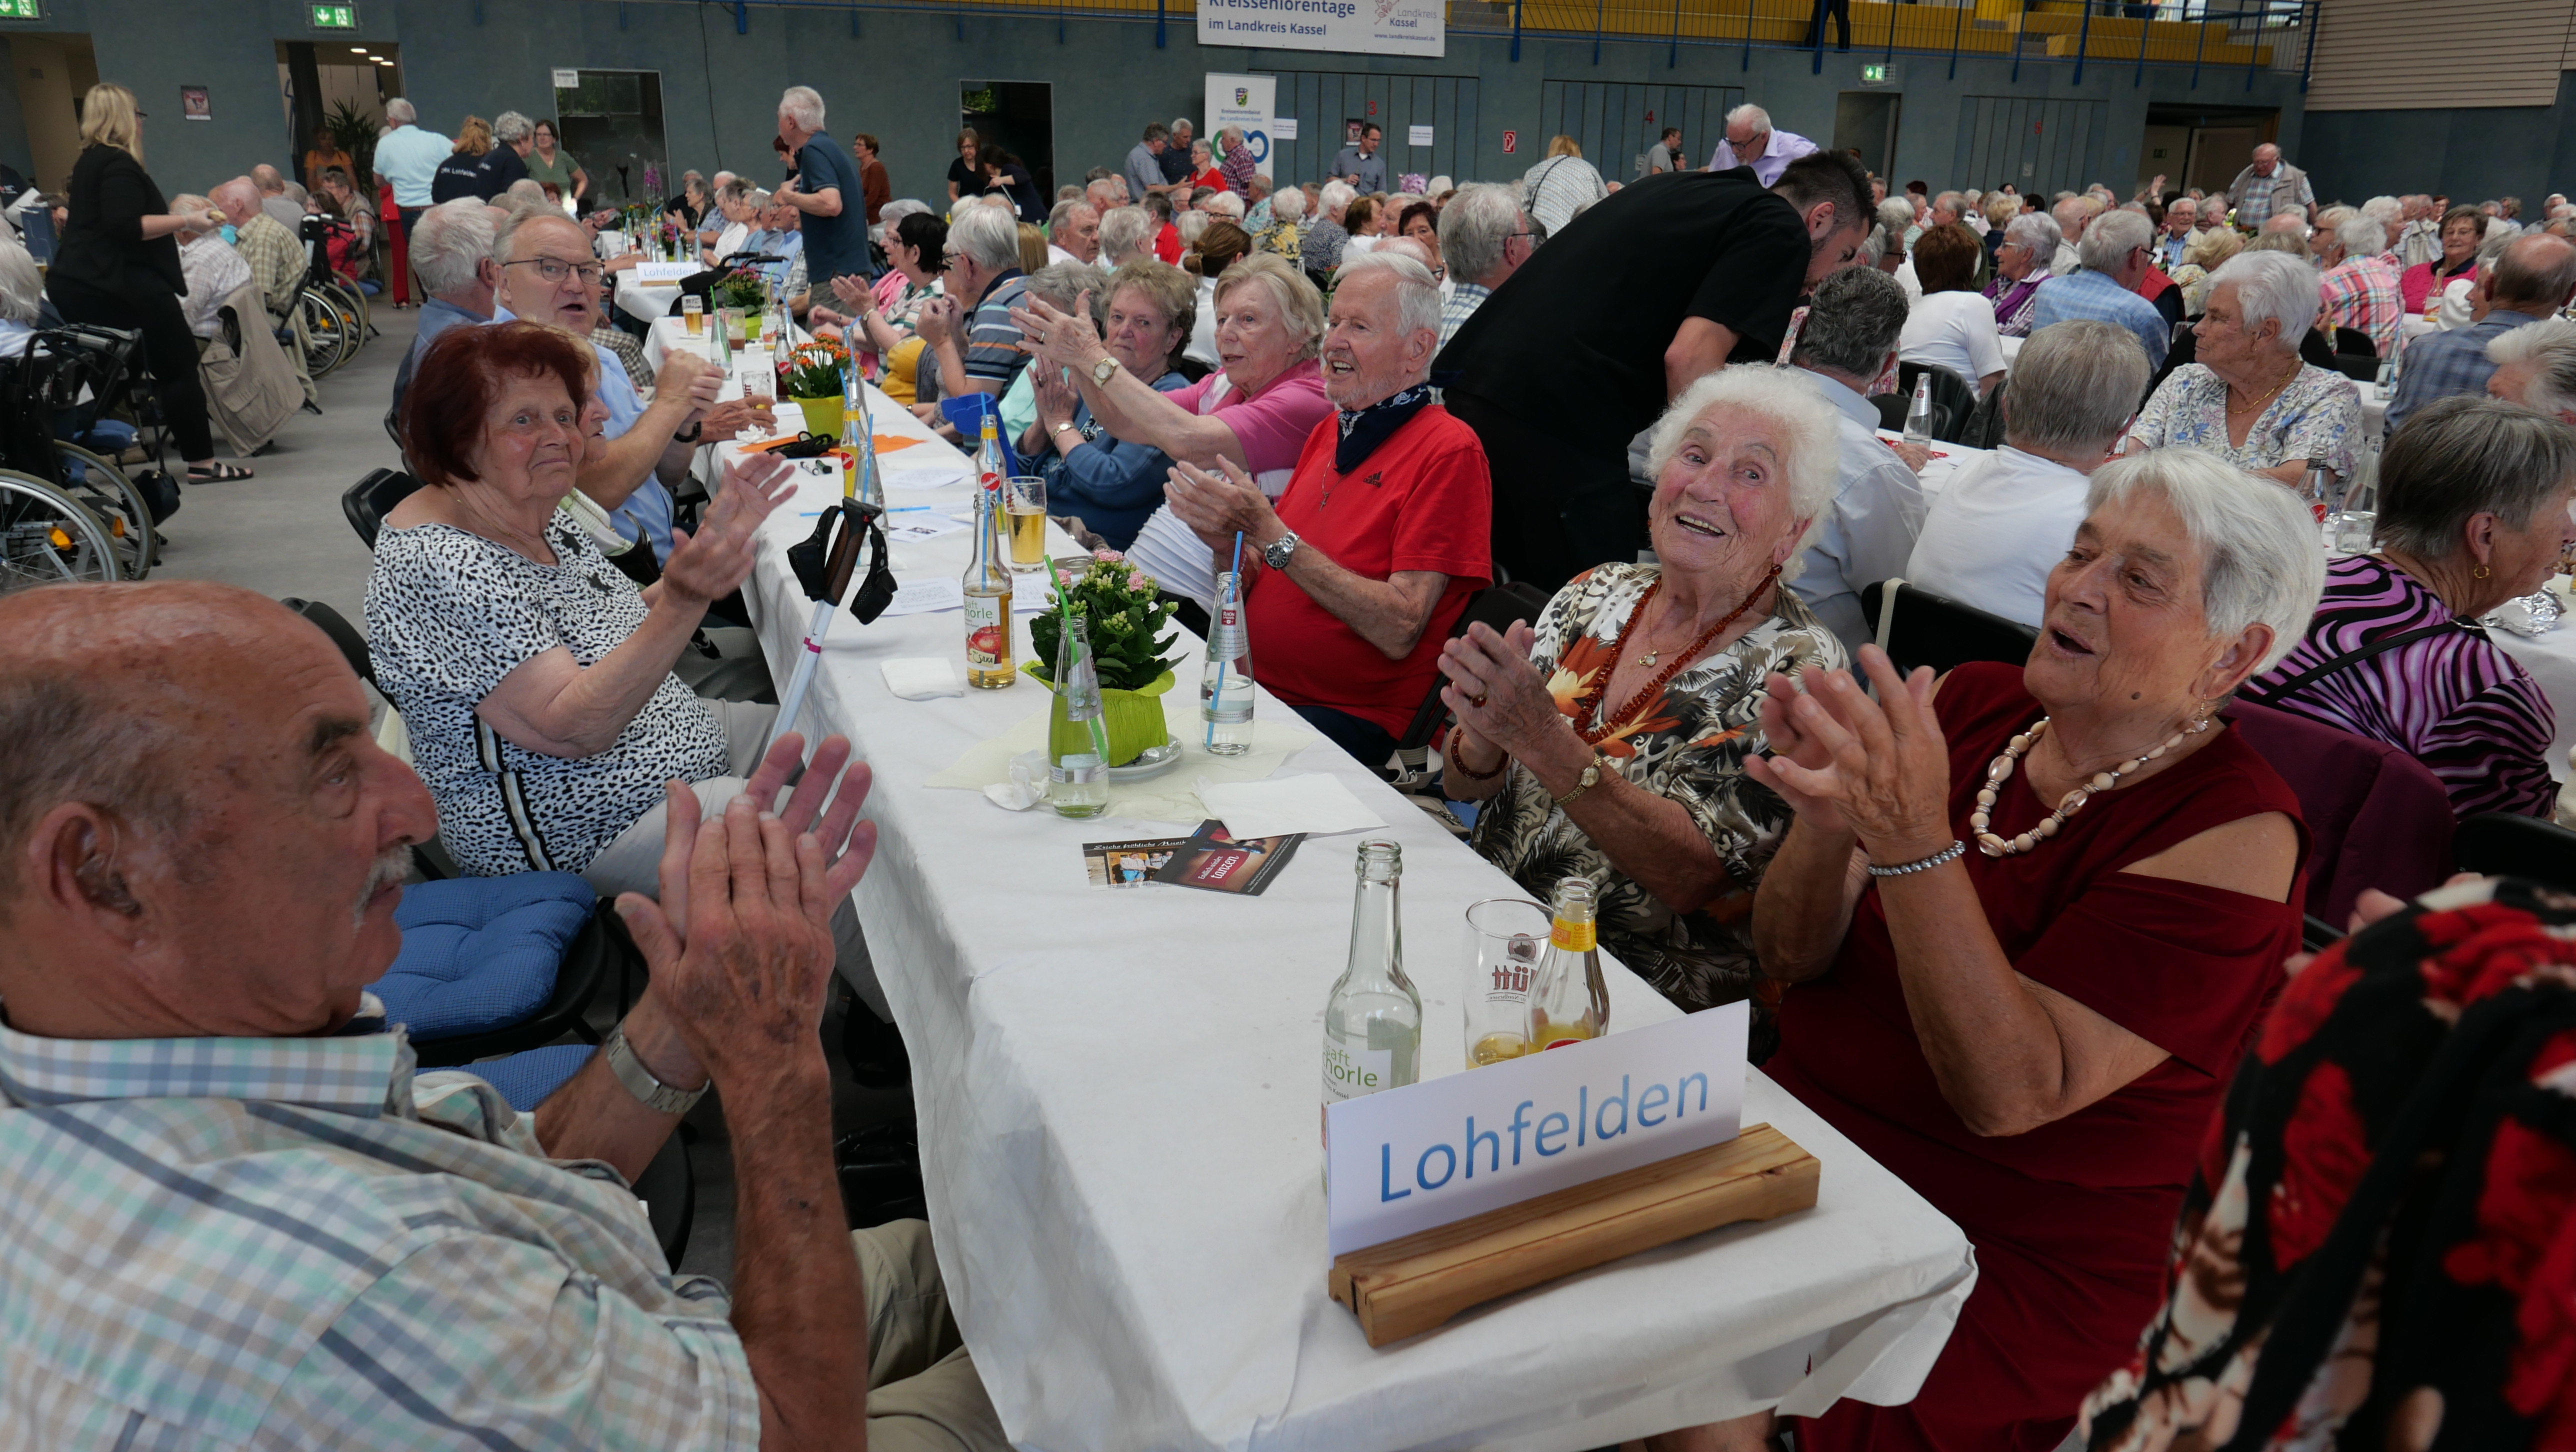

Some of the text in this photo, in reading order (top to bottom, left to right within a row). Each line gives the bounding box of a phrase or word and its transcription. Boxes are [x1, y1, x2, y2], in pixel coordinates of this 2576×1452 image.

[1398, 8, 1438, 18] Landkreis
[1208, 18, 1326, 35] im Landkreis Kassel
[1390, 18, 1418, 28] Kassel
[1374, 33, 1436, 42] www.landkreiskassel.de
[1368, 100, 1378, 116] 3
[1644, 110, 1654, 124] 4
[2034, 121, 2042, 134] 5
[644, 268, 696, 276] Lohfelden
[1210, 855, 1239, 879] tanzen
[1333, 1088, 1349, 1100] Kassel
[1381, 1070, 1709, 1203] Lohfelden
